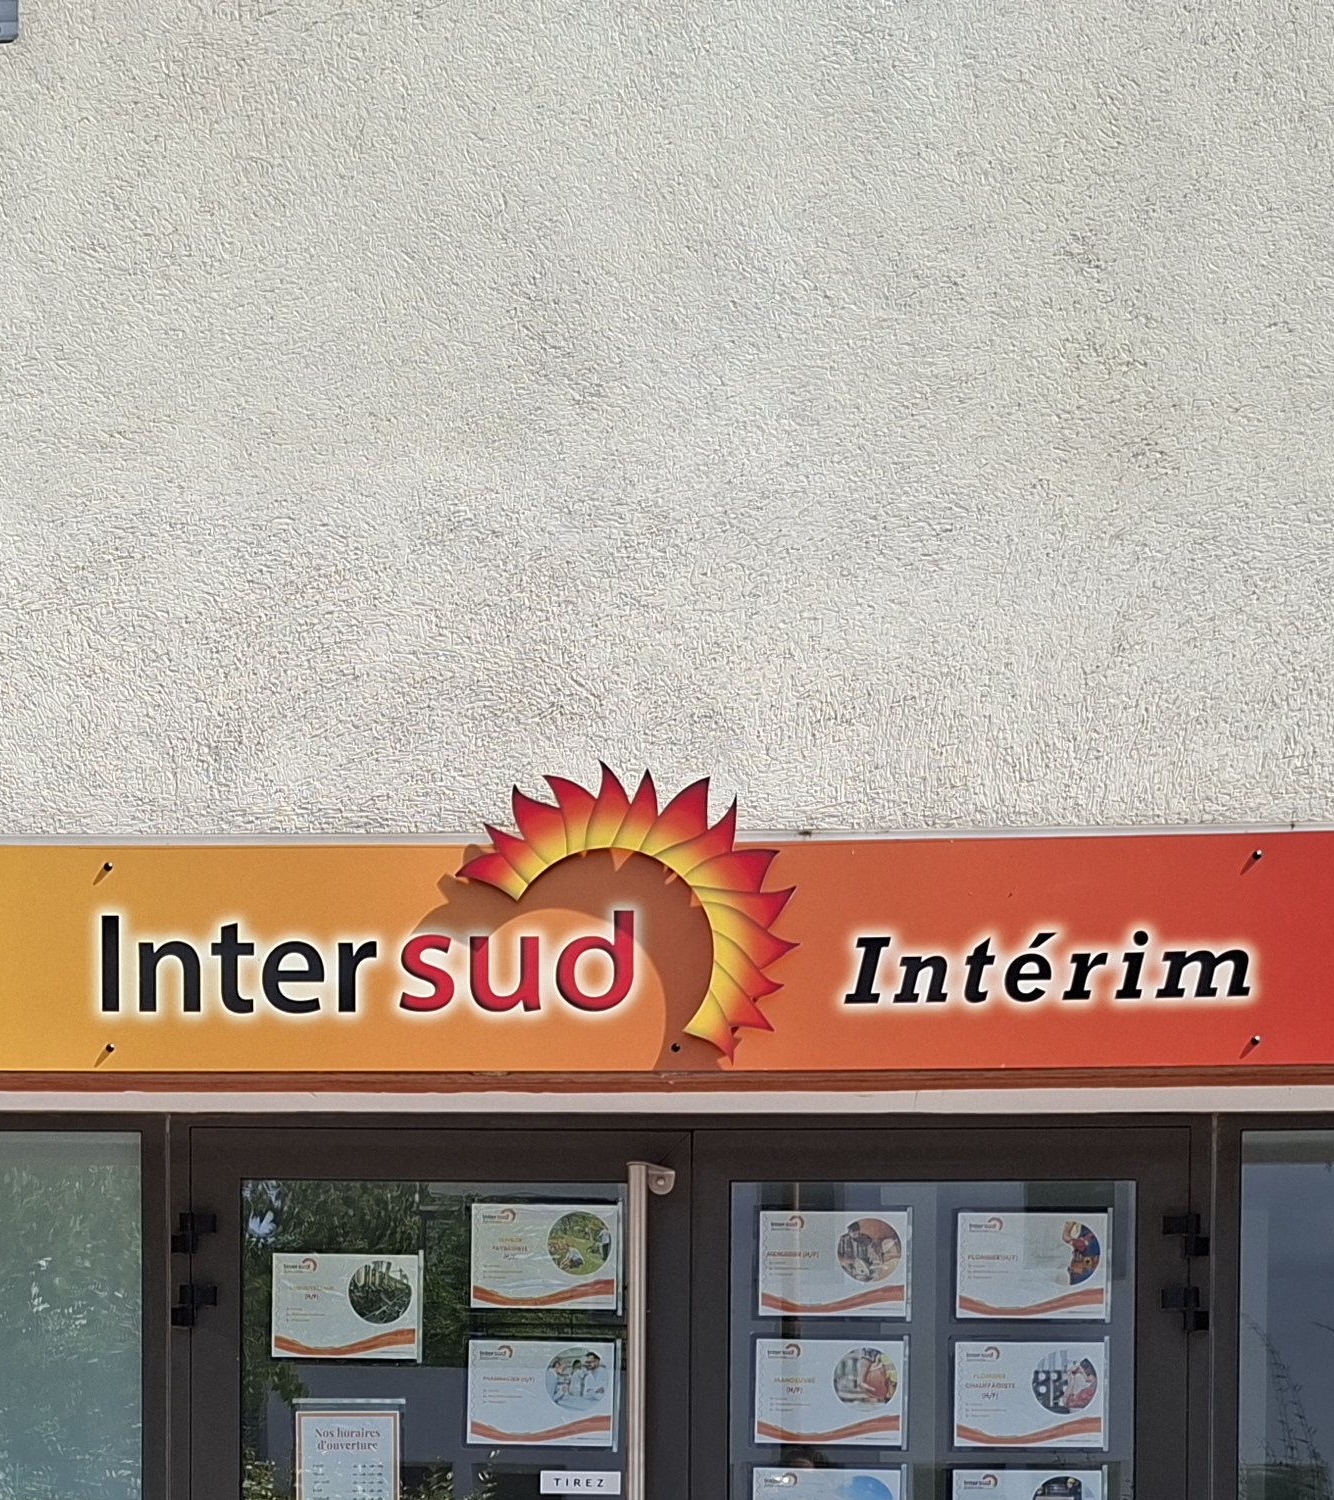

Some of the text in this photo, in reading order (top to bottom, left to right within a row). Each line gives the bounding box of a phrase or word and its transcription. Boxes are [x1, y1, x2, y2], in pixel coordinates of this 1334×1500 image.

[844, 931, 1250, 1004] Intérim
[315, 1427, 381, 1438] Nos horaires
[553, 1477, 604, 1488] TIREZ
